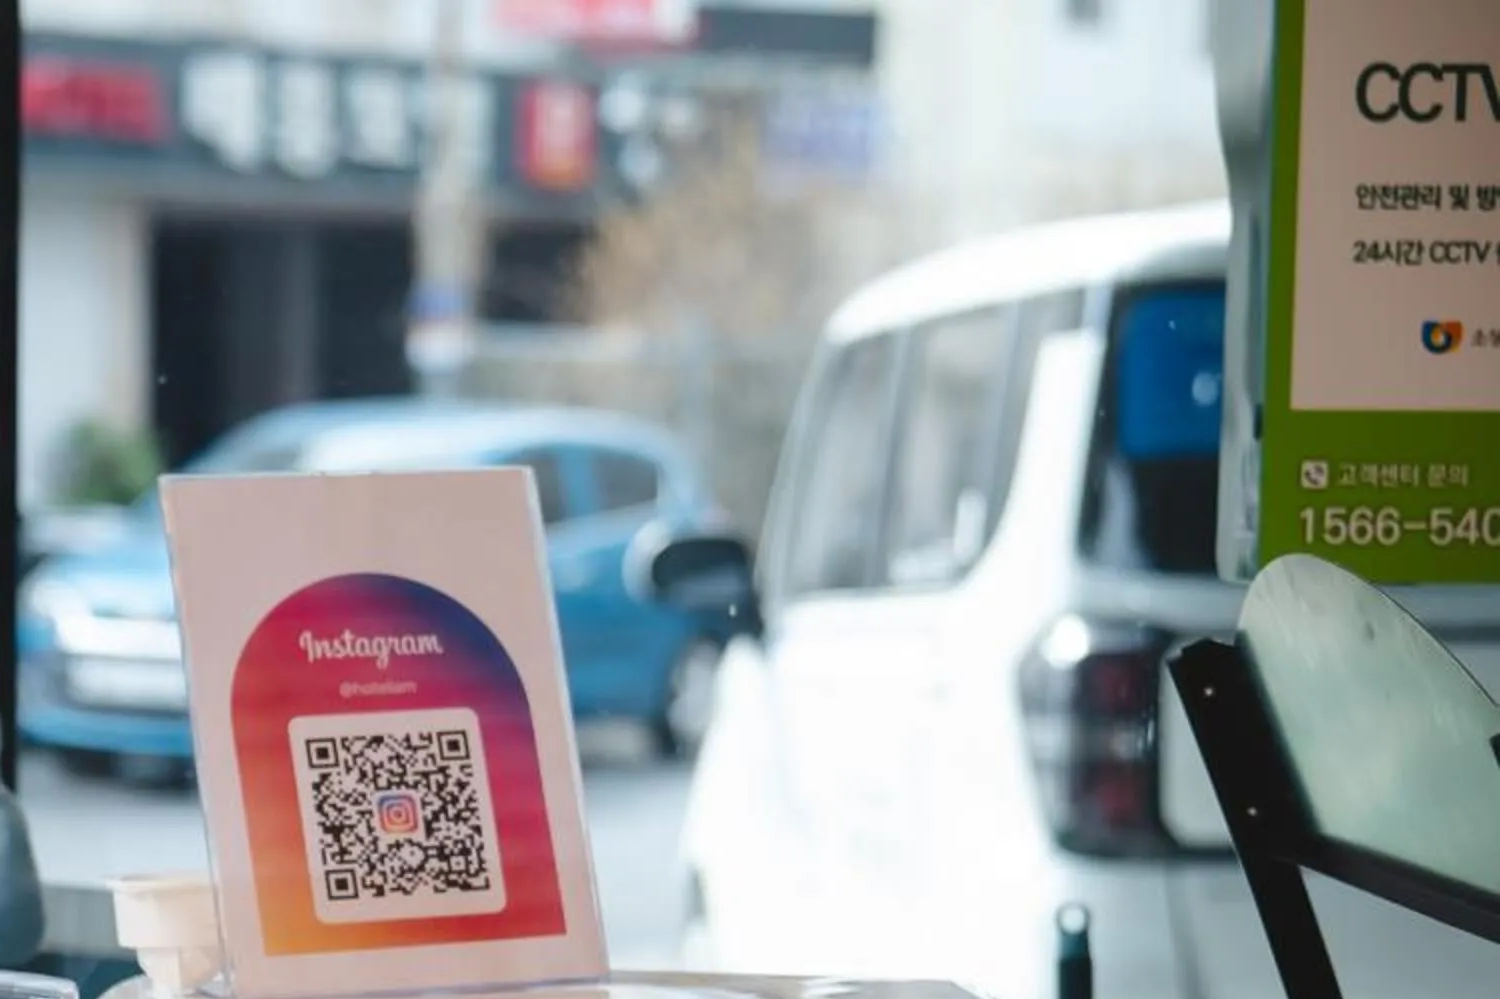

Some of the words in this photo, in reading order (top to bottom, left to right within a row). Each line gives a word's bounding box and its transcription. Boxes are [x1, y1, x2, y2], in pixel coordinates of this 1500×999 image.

[1356, 184, 1441, 211] 안전관리
[1448, 184, 1469, 211] 및
[1353, 240, 1423, 266] 24시간
[1429, 240, 1491, 264] CCTV
[1339, 463, 1419, 487] 고객센터
[1428, 463, 1469, 487] 문의
[299, 628, 444, 670] Instagram
